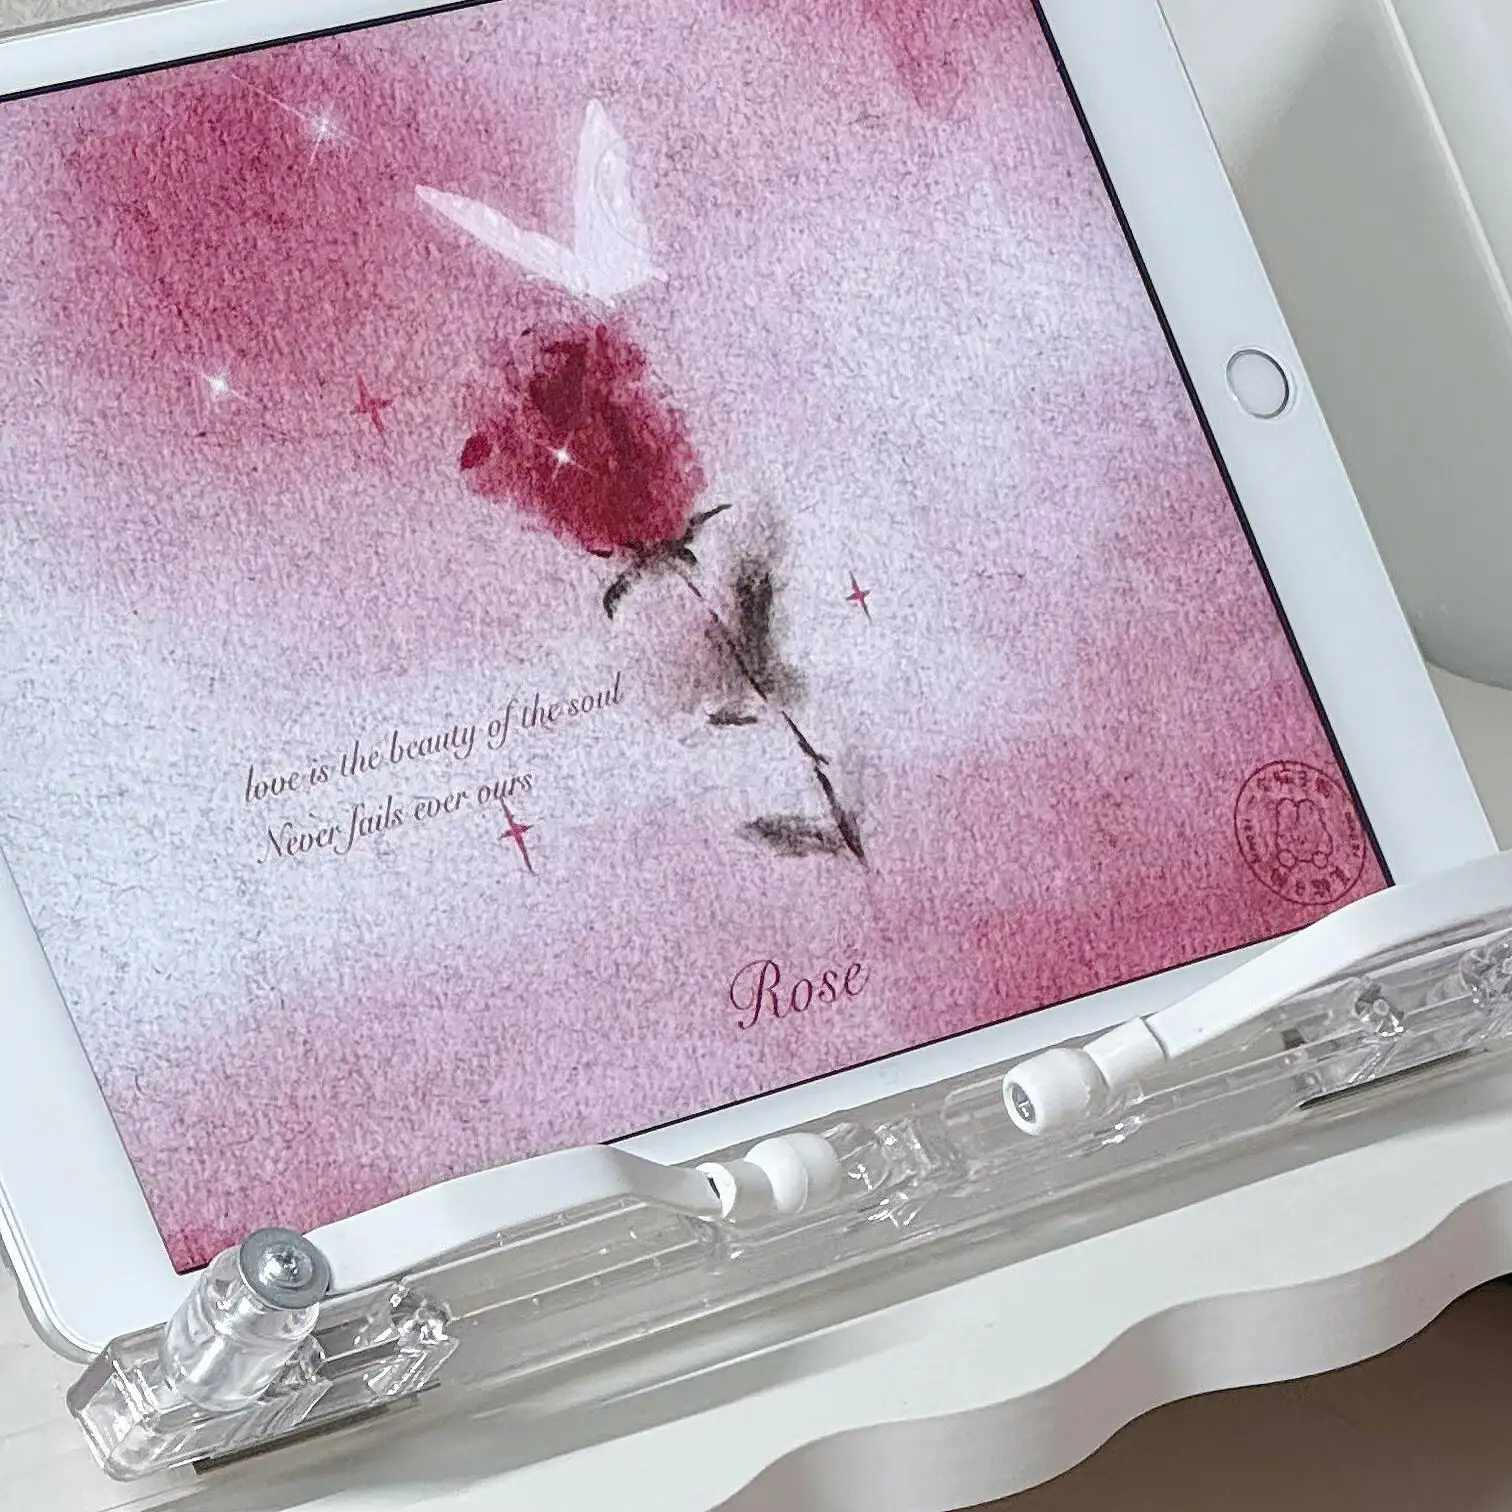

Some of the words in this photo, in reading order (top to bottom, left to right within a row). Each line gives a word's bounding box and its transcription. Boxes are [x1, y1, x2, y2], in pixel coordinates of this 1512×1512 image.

[245, 764, 301, 802] love
[310, 757, 330, 784] is
[340, 739, 382, 777] the
[391, 729, 478, 761] beauty
[487, 698, 517, 751] of
[521, 693, 563, 728] the
[567, 671, 626, 716] soul
[257, 821, 343, 865] Never
[333, 794, 405, 856] fails
[413, 788, 469, 821] ever
[477, 772, 534, 806] ours
[728, 957, 871, 1031] Rose
